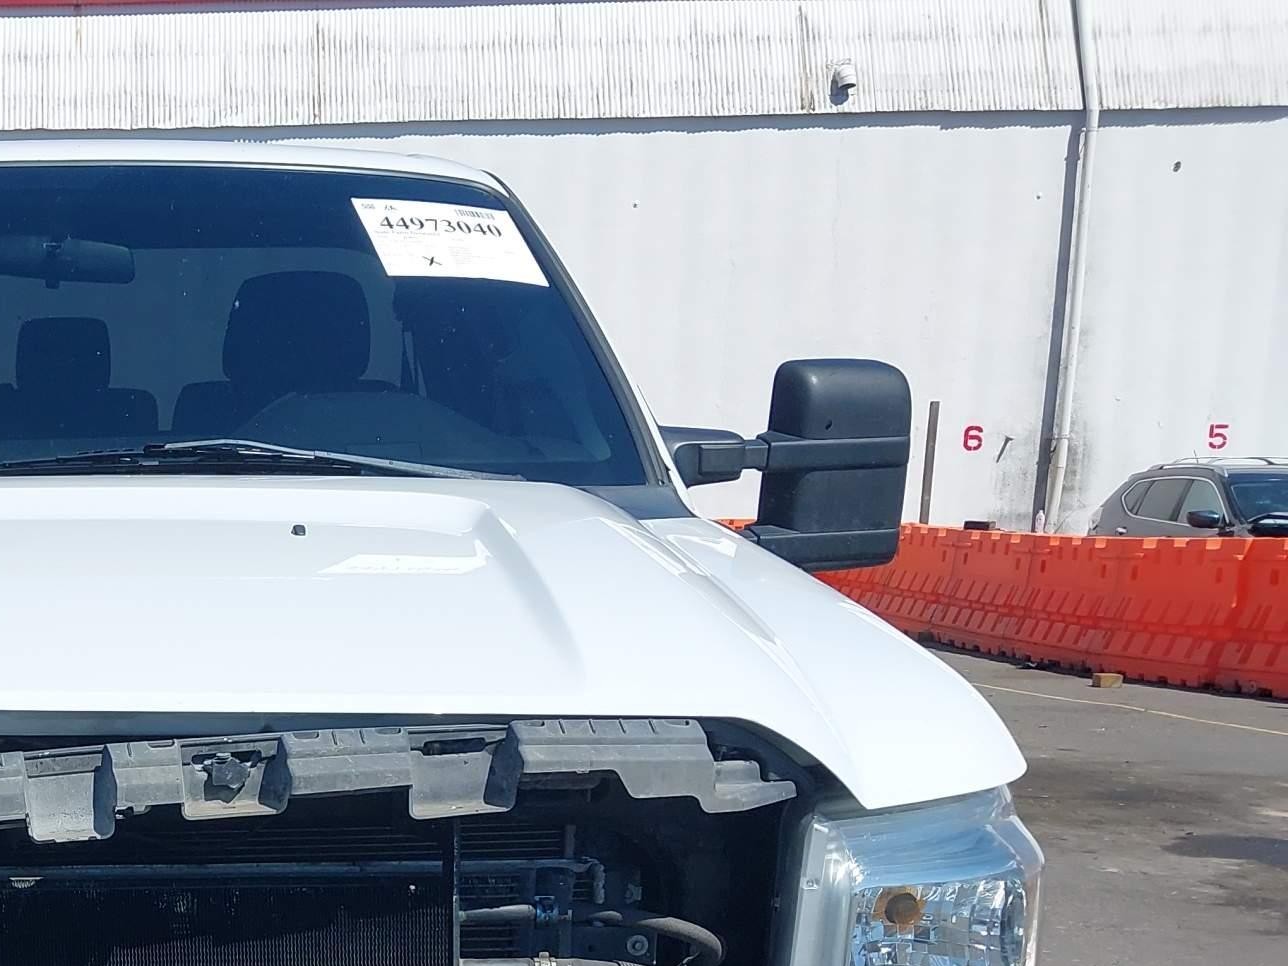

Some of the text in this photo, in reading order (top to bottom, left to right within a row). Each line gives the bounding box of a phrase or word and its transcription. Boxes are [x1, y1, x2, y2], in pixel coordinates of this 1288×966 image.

[379, 216, 503, 238] 44973040
[962, 425, 984, 451] 6
[1207, 424, 1229, 449] 5
